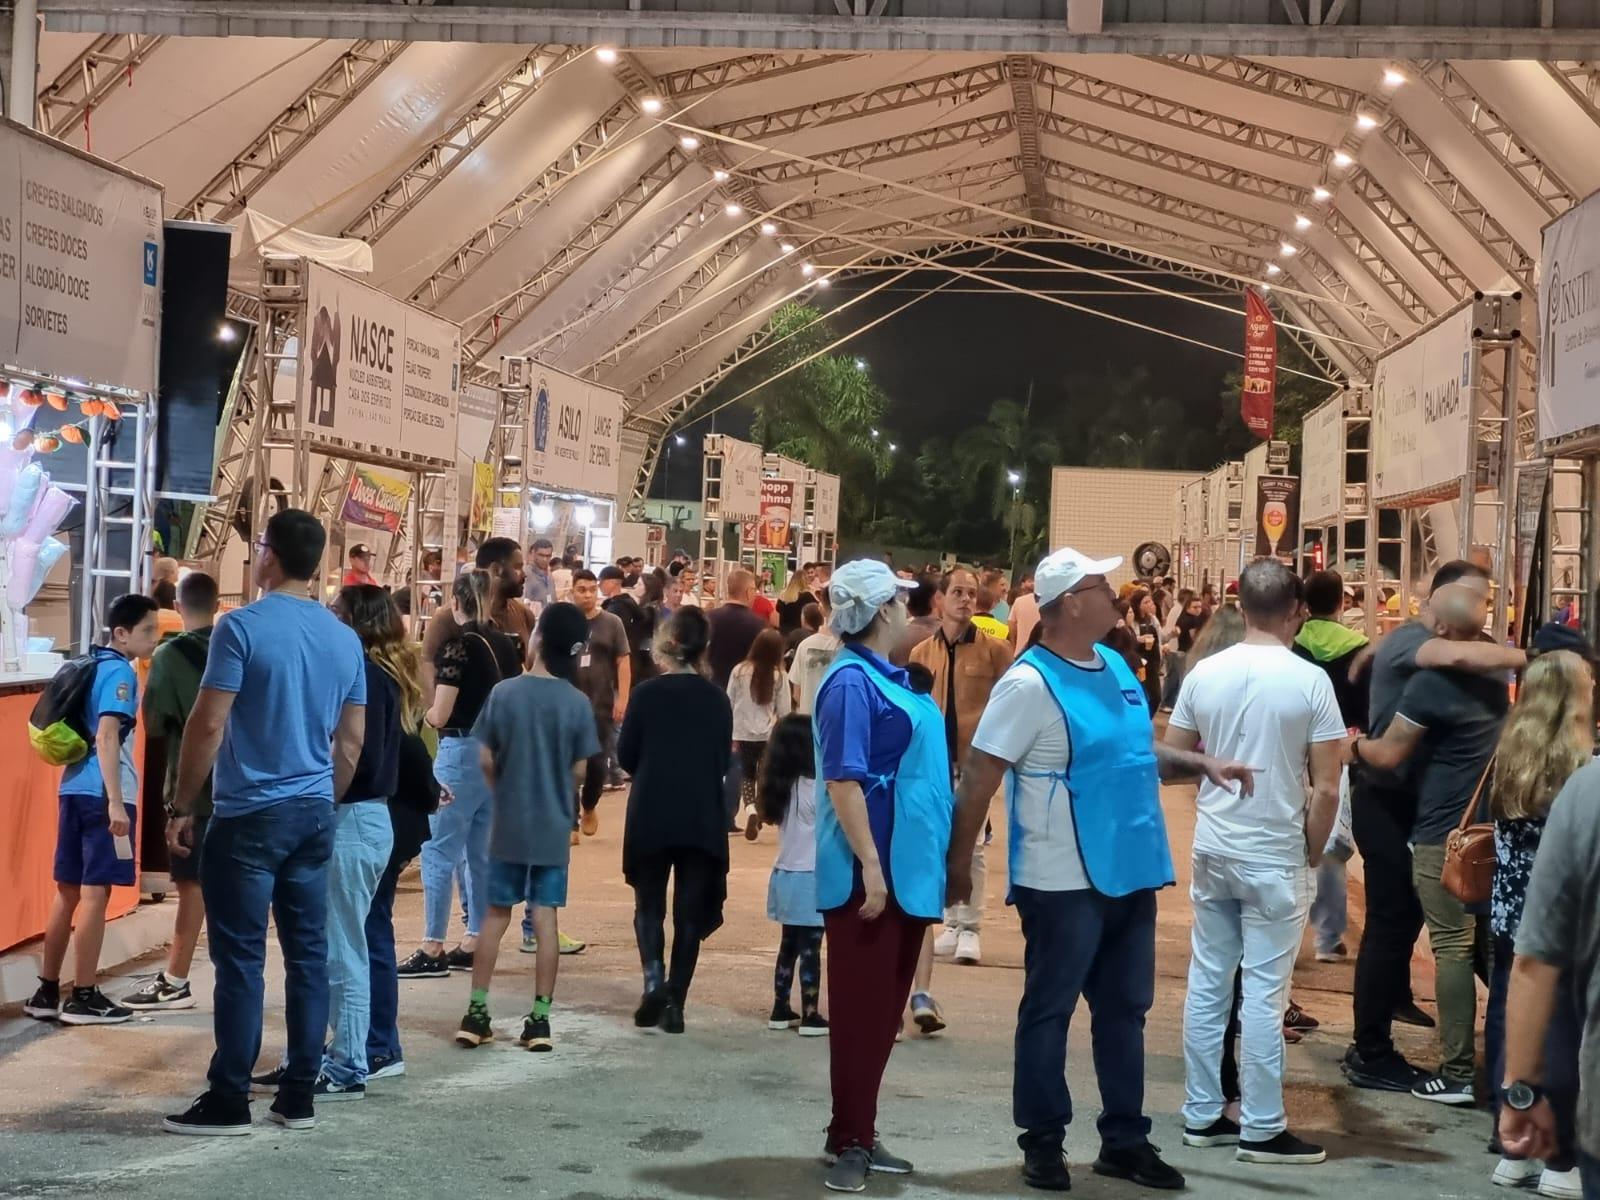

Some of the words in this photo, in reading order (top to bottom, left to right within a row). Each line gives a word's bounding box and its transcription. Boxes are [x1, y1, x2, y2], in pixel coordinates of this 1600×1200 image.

[26, 180, 59, 211] CREPES
[61, 192, 104, 226] SALGADOS
[25, 221, 59, 252] CREPES
[60, 231, 88, 260] DOCES
[0, 252, 16, 280] ER
[25, 262, 66, 294] ALGODÃO
[67, 275, 90, 301] DOCE
[25, 303, 68, 335] SORVETES
[350, 313, 395, 374] NASCE
[1424, 376, 1460, 425] GALINHADA
[557, 404, 582, 442] ASILO
